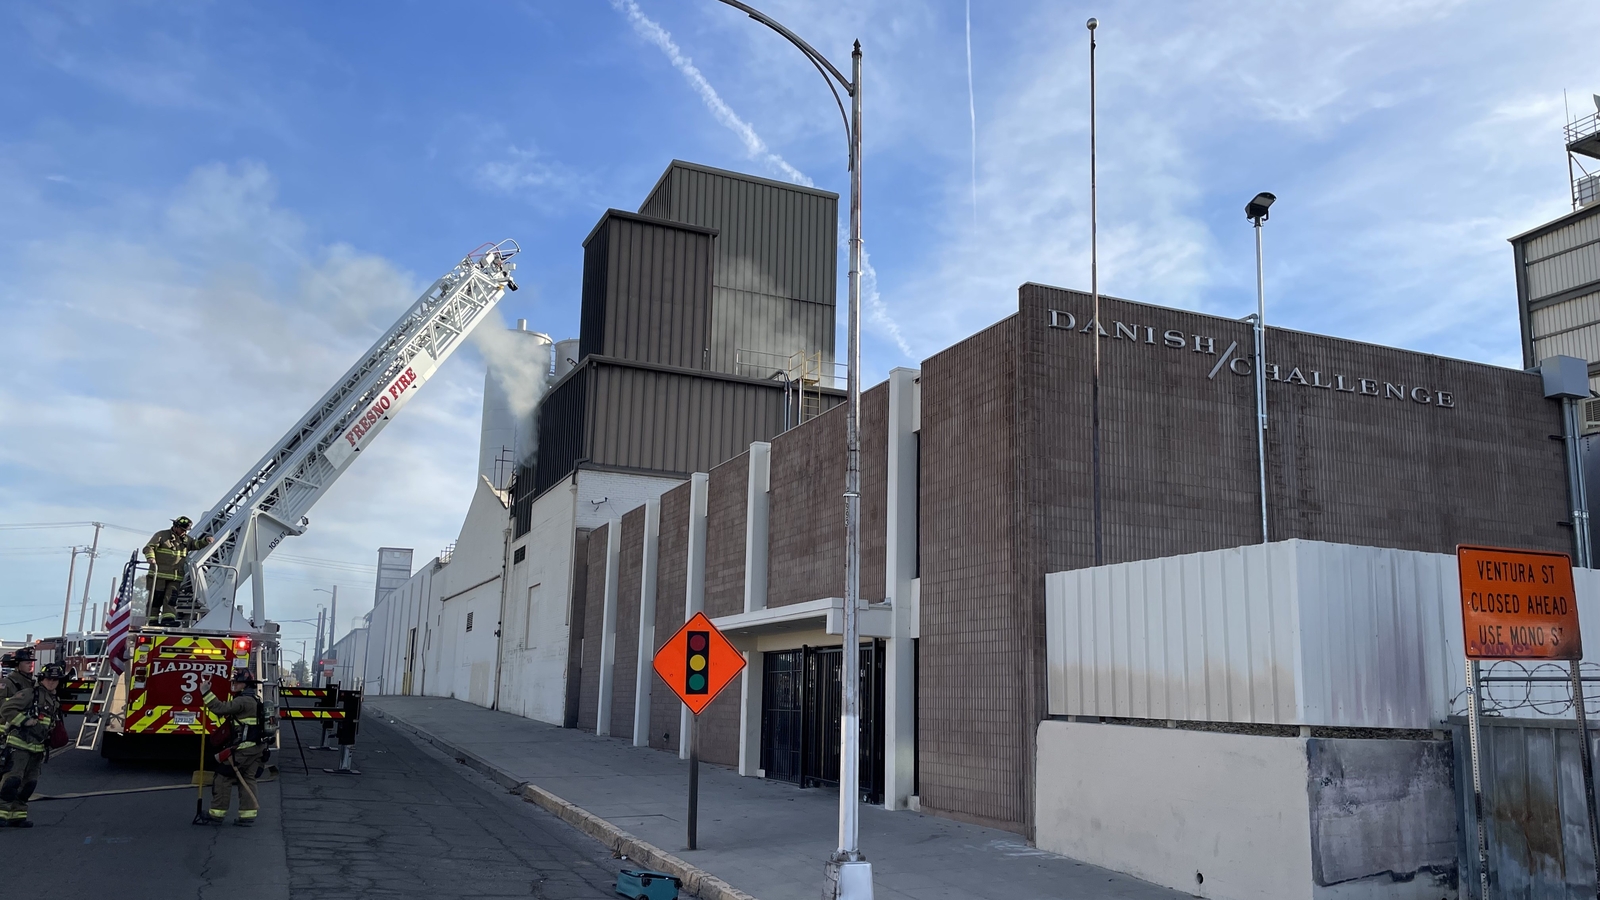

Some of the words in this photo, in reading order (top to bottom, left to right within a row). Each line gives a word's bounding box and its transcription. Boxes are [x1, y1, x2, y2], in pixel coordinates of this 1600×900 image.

[344, 395, 391, 448] FRESNO
[388, 366, 418, 401] FIRE
[268, 537, 280, 550] 105
[279, 530, 286, 539] FT
[1476, 560, 1536, 583] VENTURA
[1541, 565, 1555, 584] ST
[1471, 592, 1520, 614] CLOSED
[1527, 595, 1568, 615] AHEAD
[1479, 625, 1503, 646] USE
[1510, 626, 1545, 647] MONO
[151, 661, 229, 679] LADDER
[180, 672, 199, 692] 3
